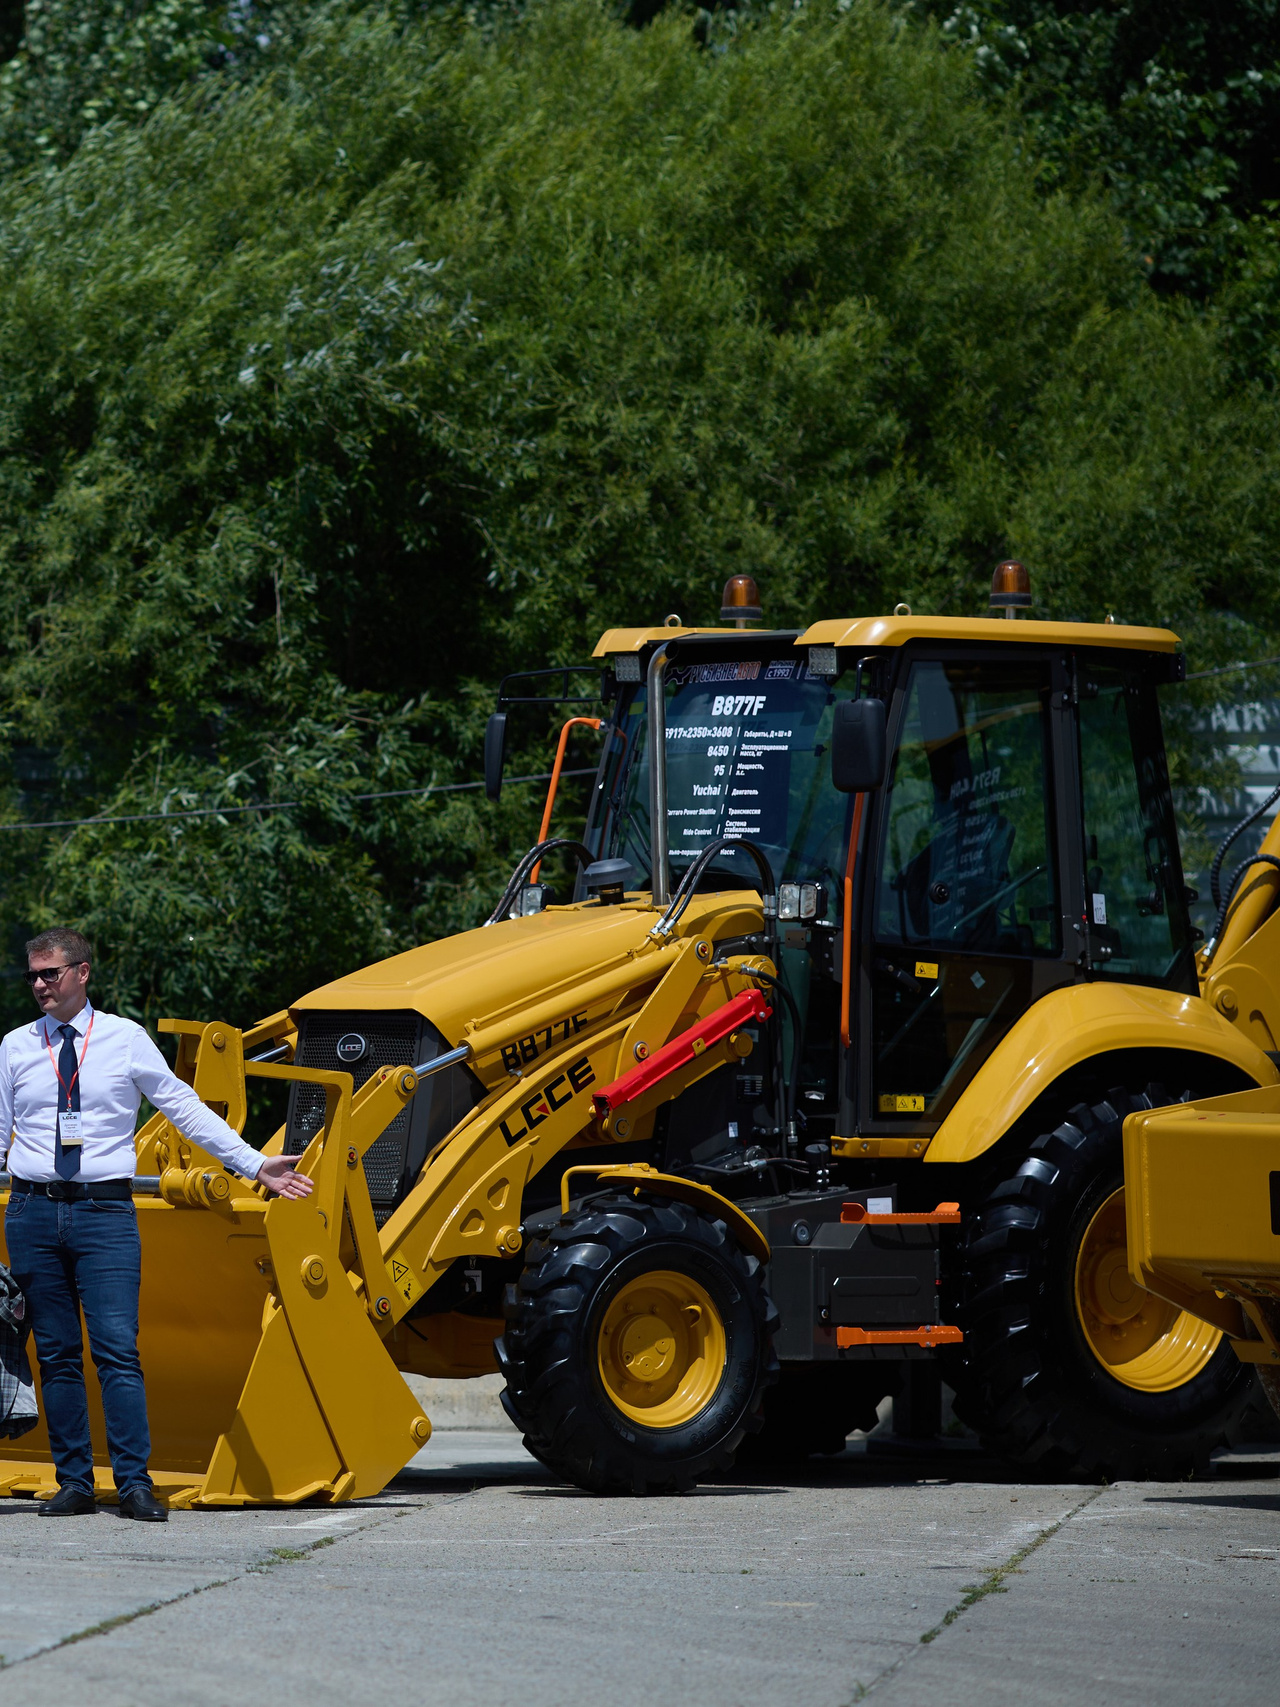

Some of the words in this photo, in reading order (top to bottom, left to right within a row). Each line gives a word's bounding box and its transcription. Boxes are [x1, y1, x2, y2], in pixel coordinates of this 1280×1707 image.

[773, 668, 790, 678] 1993
[711, 695, 767, 716] B877F
[707, 745, 729, 757] 8450
[713, 764, 725, 776] 95
[692, 784, 721, 796] Yuchai
[731, 788, 759, 796] Двигатель
[683, 808, 698, 816] Power
[728, 807, 761, 816] Трансмиссия
[682, 828, 693, 836] Ride
[693, 828, 712, 836] Control
[500, 1010, 588, 1072] B877F
